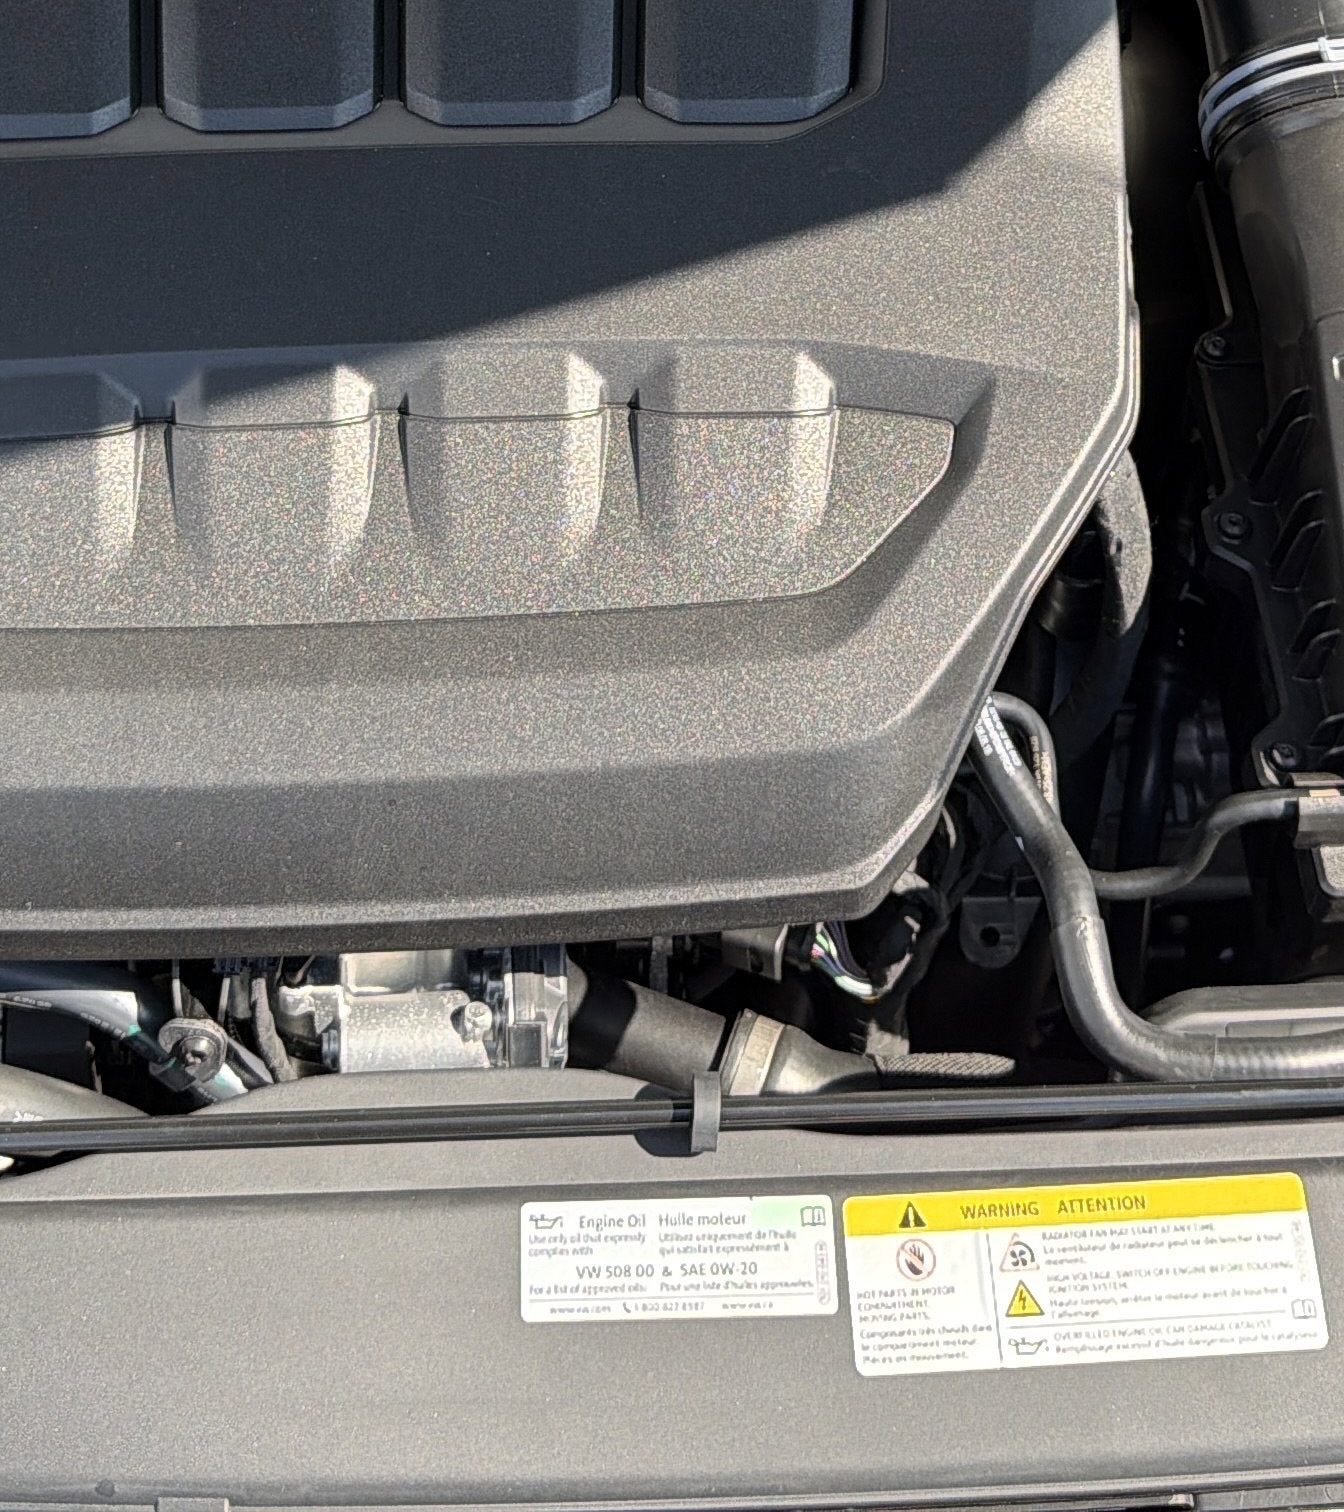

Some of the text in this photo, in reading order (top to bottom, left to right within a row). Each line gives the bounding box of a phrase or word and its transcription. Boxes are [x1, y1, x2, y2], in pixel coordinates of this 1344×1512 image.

[960, 1194, 1146, 1220] WARNING ATTENTION
[579, 1214, 646, 1232] Engine Oil
[658, 1213, 747, 1227] Huile moteur
[576, 1262, 758, 1279] VW 508 00 & SAE 0W-20
